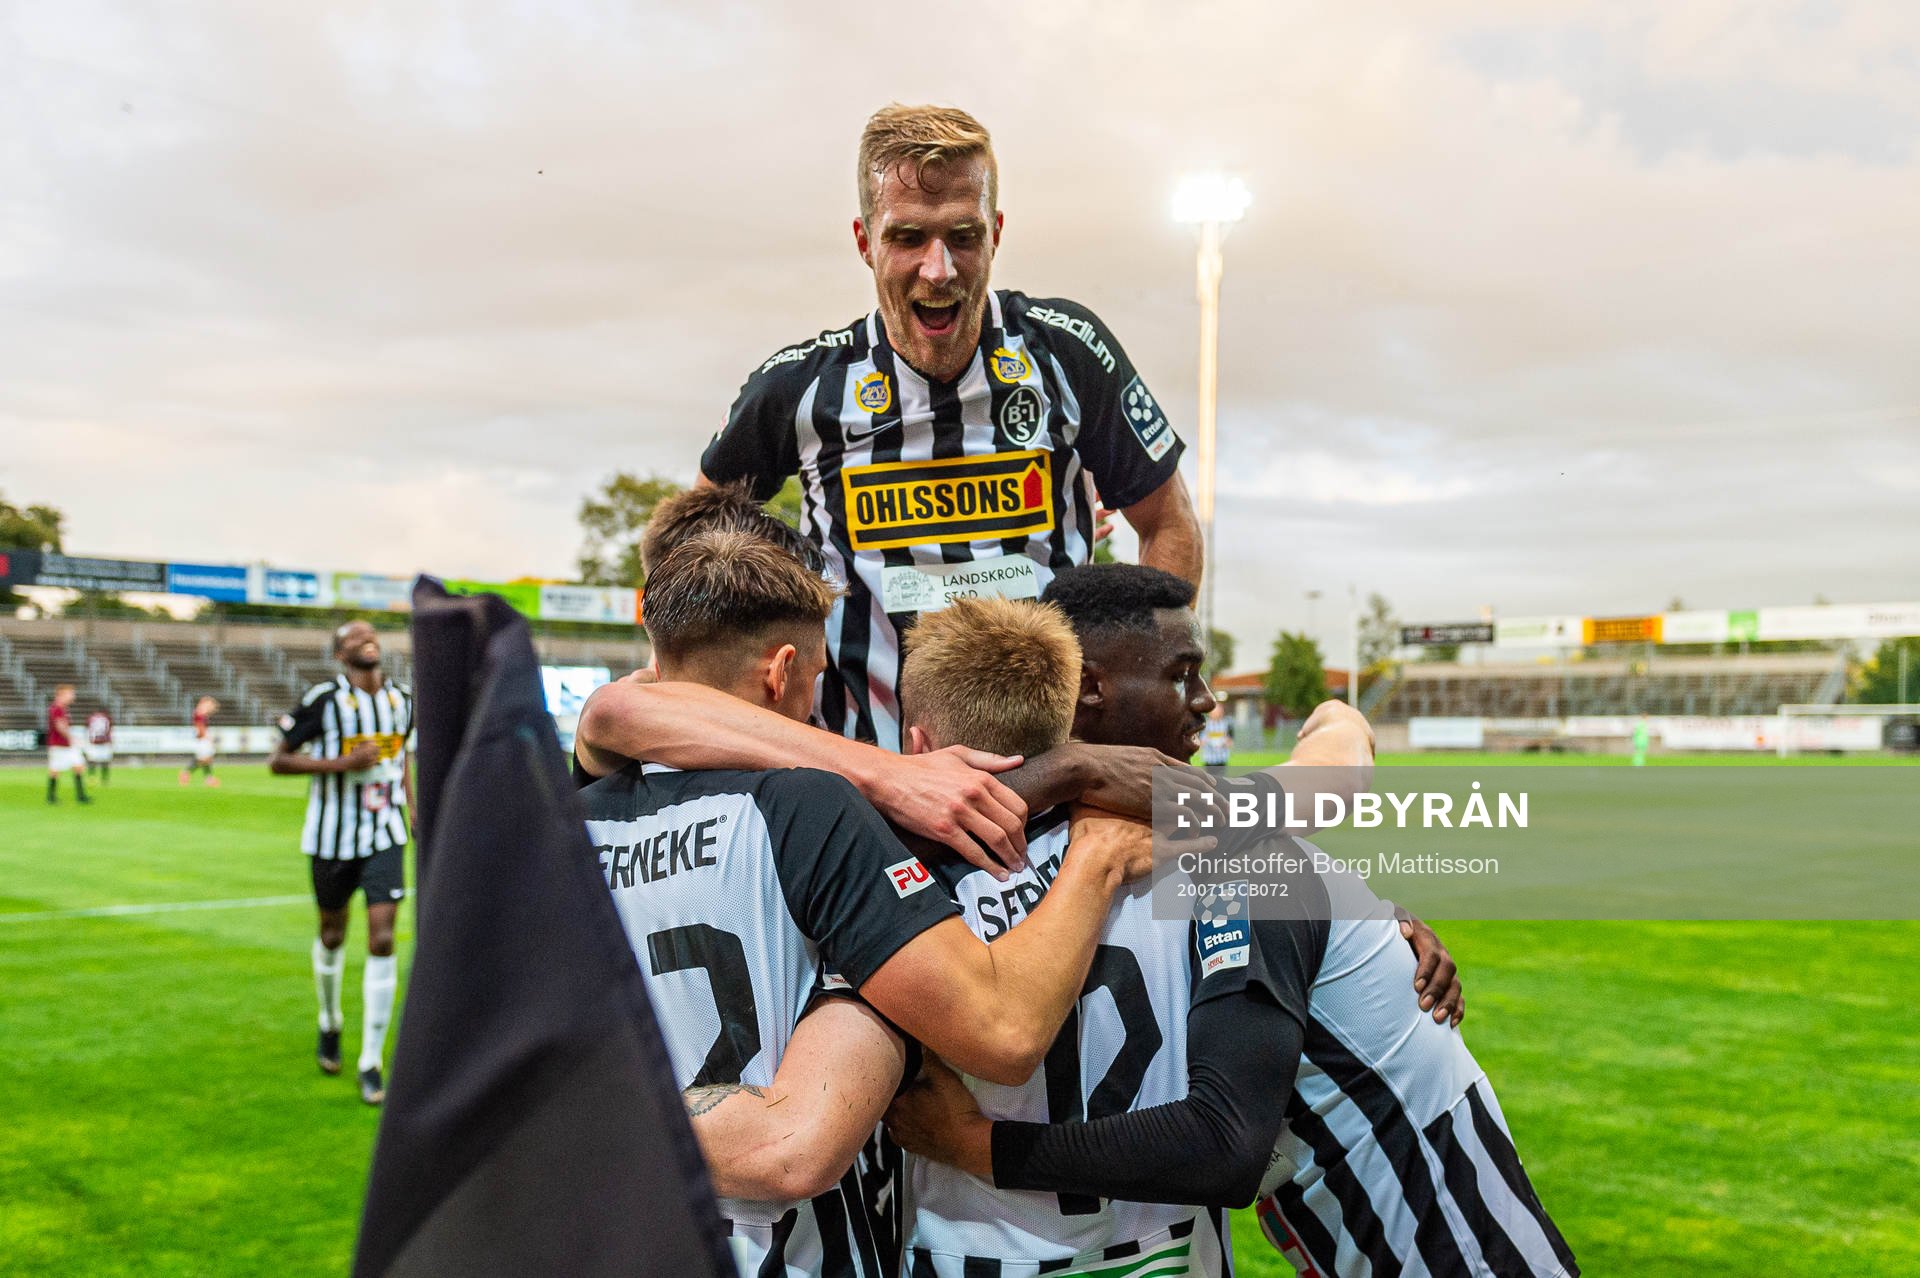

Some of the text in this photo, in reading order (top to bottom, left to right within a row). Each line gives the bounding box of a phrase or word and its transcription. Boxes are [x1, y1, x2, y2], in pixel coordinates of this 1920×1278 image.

[1026, 306, 1116, 374] stadium
[856, 478, 1021, 525] OHLSSONS
[942, 564, 1034, 588] LANDSKRONA
[1203, 929, 1244, 951] Ettan
